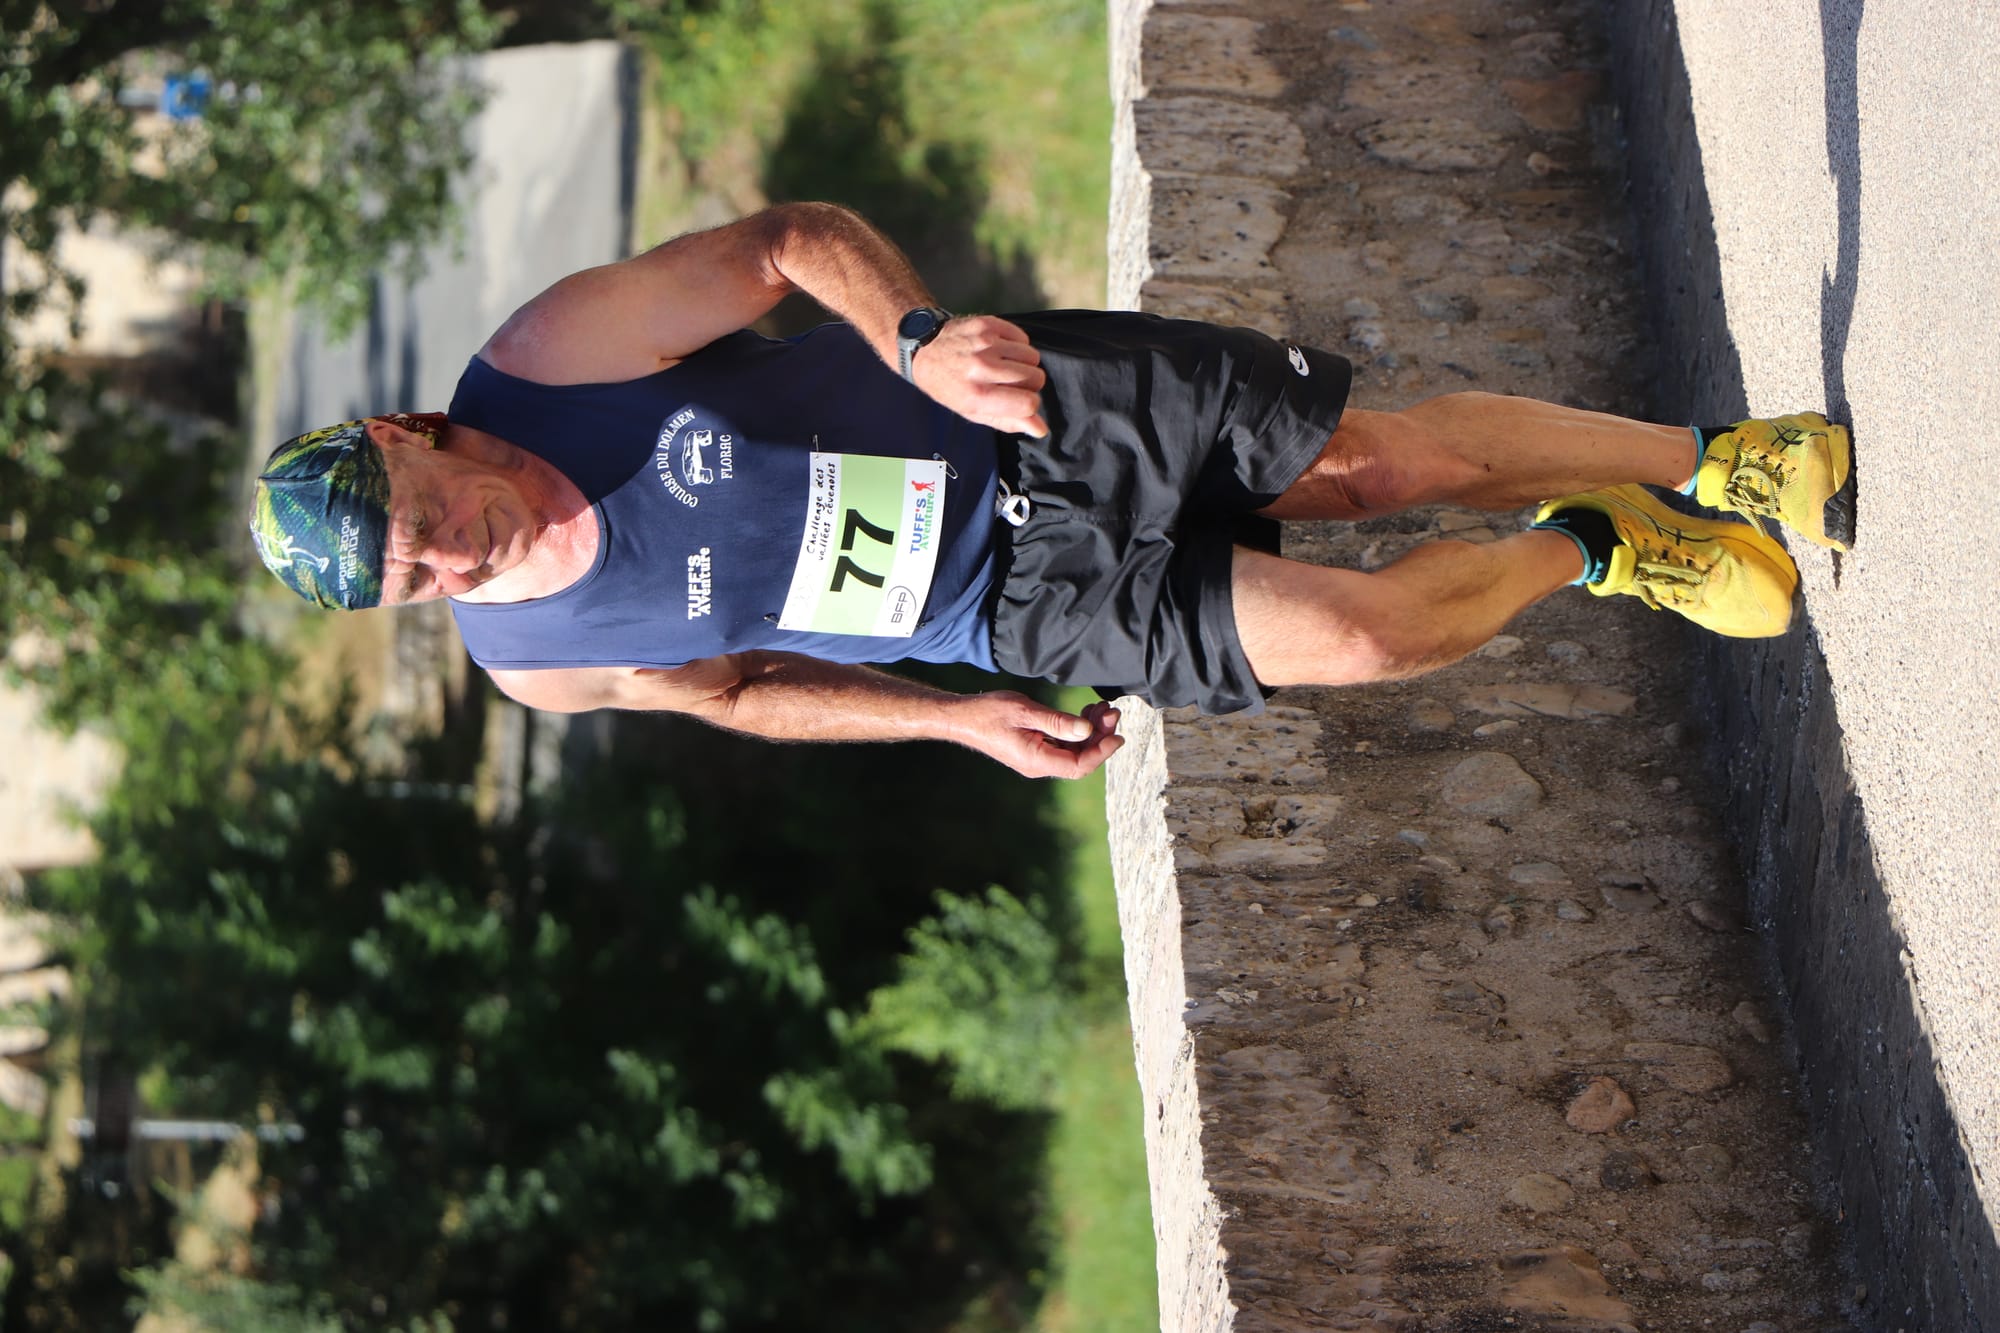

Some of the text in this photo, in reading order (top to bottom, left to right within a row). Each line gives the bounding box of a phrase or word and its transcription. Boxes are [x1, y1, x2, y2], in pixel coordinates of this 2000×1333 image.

[656, 408, 698, 508] COURSE DU DOLMEN
[719, 434, 733, 480] FLORAC
[806, 467, 825, 554] Challenge des
[817, 463, 836, 561] vallées cévenoles
[909, 497, 928, 554] TUFF'S
[919, 491, 936, 551] Aventure
[339, 515, 351, 591] SPORT 2000
[347, 525, 360, 579] MENDE
[699, 547, 711, 615] Aventure
[829, 508, 895, 593] 77
[688, 553, 701, 620] TUFF'S
[890, 590, 908, 624] BFP
